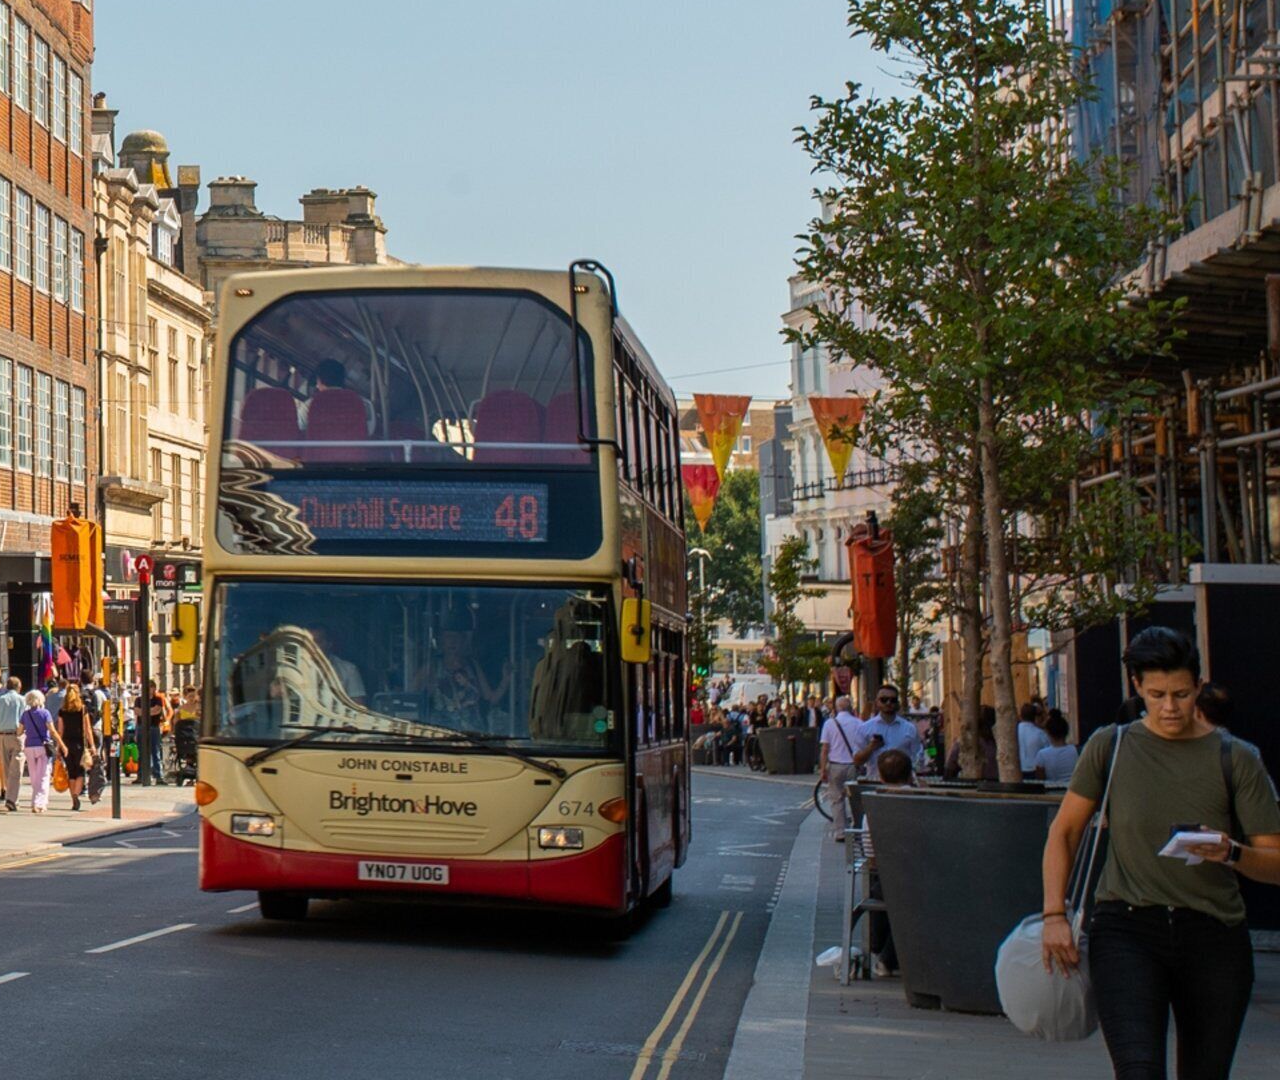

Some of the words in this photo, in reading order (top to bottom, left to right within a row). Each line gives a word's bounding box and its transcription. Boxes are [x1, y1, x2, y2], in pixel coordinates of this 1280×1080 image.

[299, 495, 385, 529] Churchill
[389, 496, 461, 531] Square
[495, 493, 538, 539] 48
[138, 558, 149, 570] A
[337, 757, 377, 771] JOHN
[381, 759, 469, 774] CONSTABLE
[558, 800, 594, 817] 674
[365, 863, 407, 881] YN07
[411, 865, 444, 882] UOG
